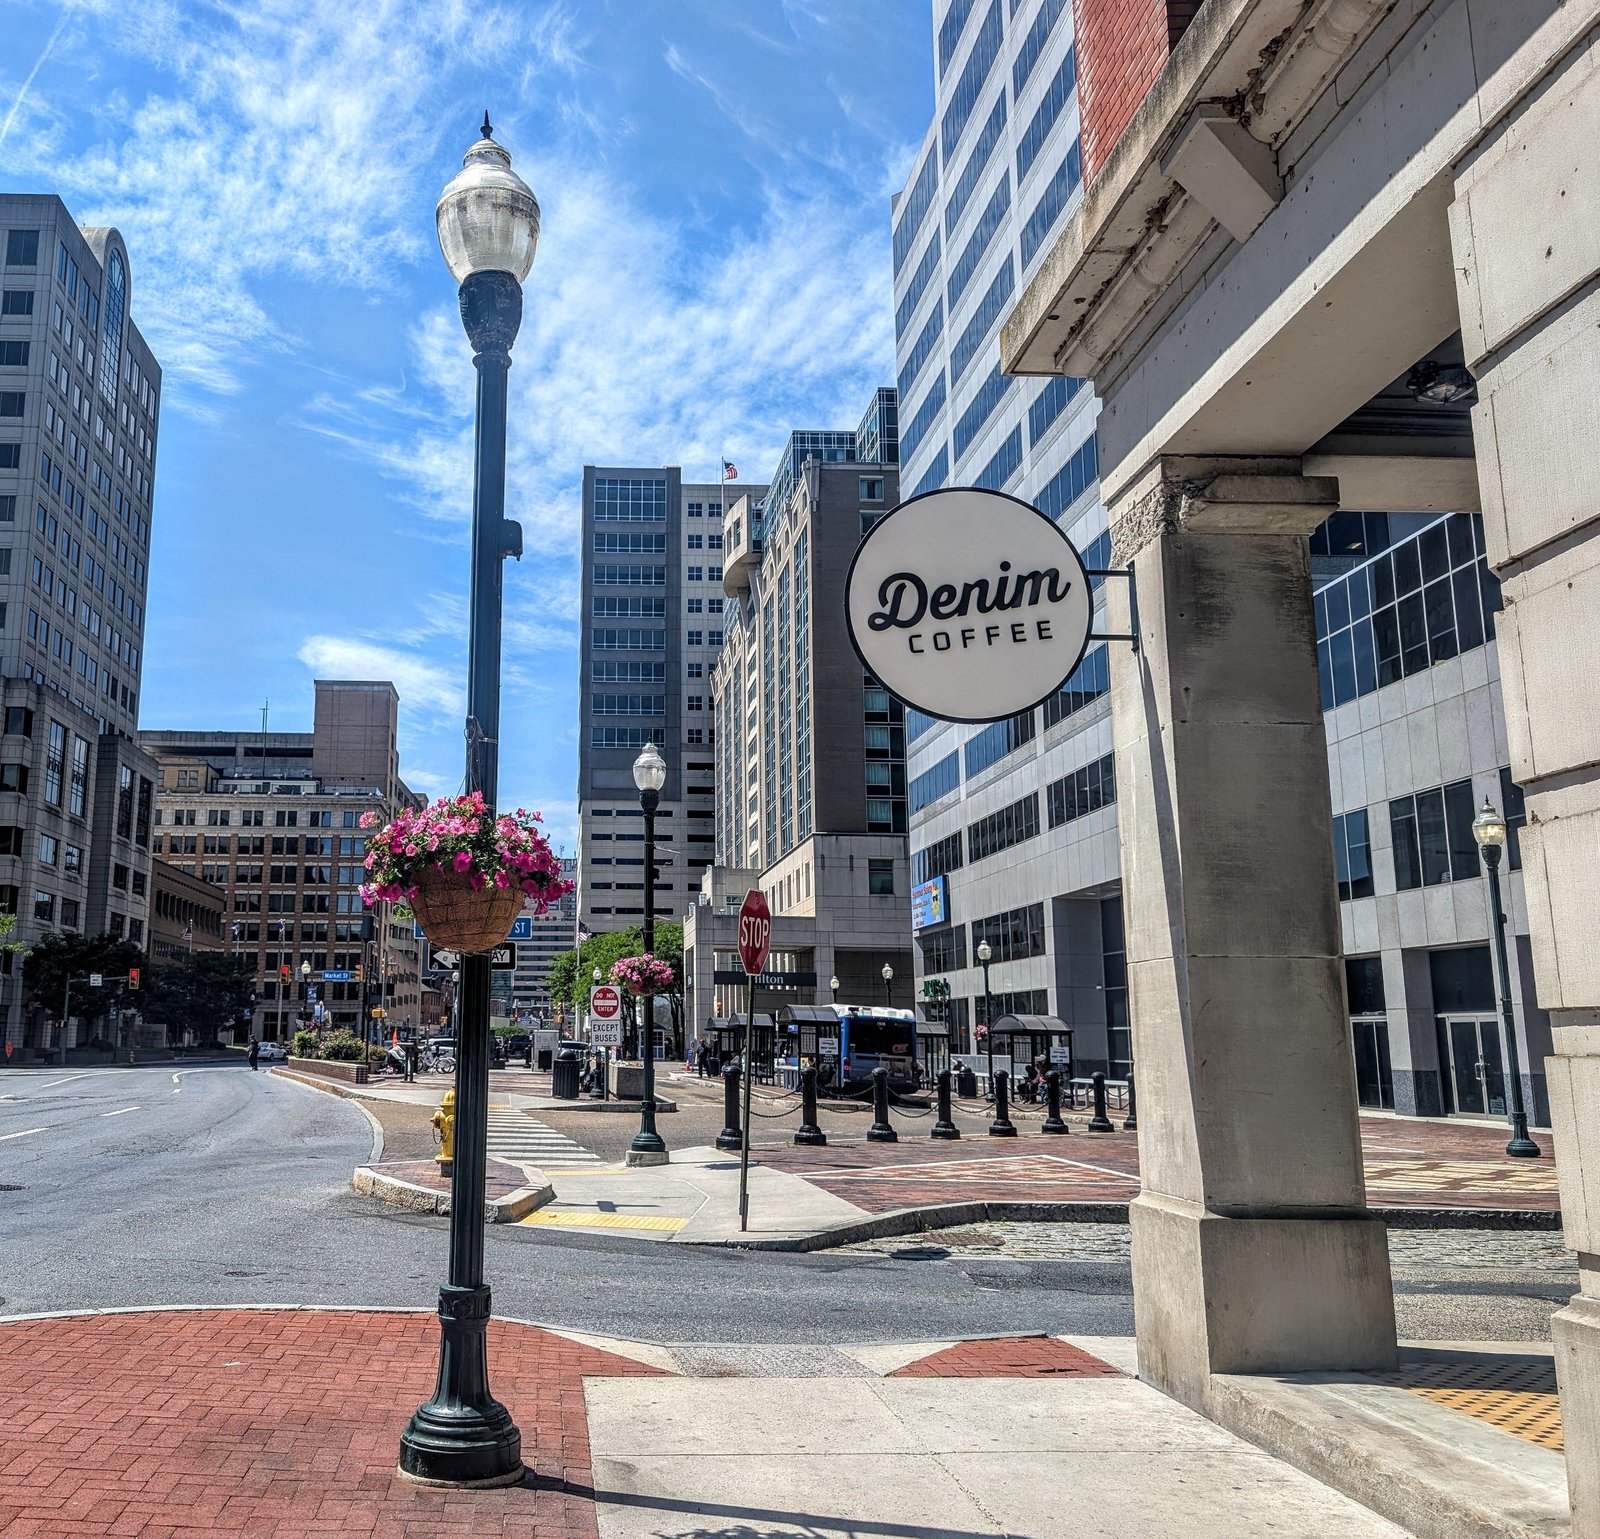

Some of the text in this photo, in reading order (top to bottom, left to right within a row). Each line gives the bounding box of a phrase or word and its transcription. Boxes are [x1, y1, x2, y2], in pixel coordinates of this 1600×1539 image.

[867, 561, 1072, 631] Denim
[908, 620, 1053, 653] COFFEE
[515, 922, 525, 934] ST
[741, 915, 769, 948] STOP
[491, 950, 507, 962] AY
[593, 1024, 618, 1032] EXCEPT
[595, 1034, 617, 1042] BUSES
